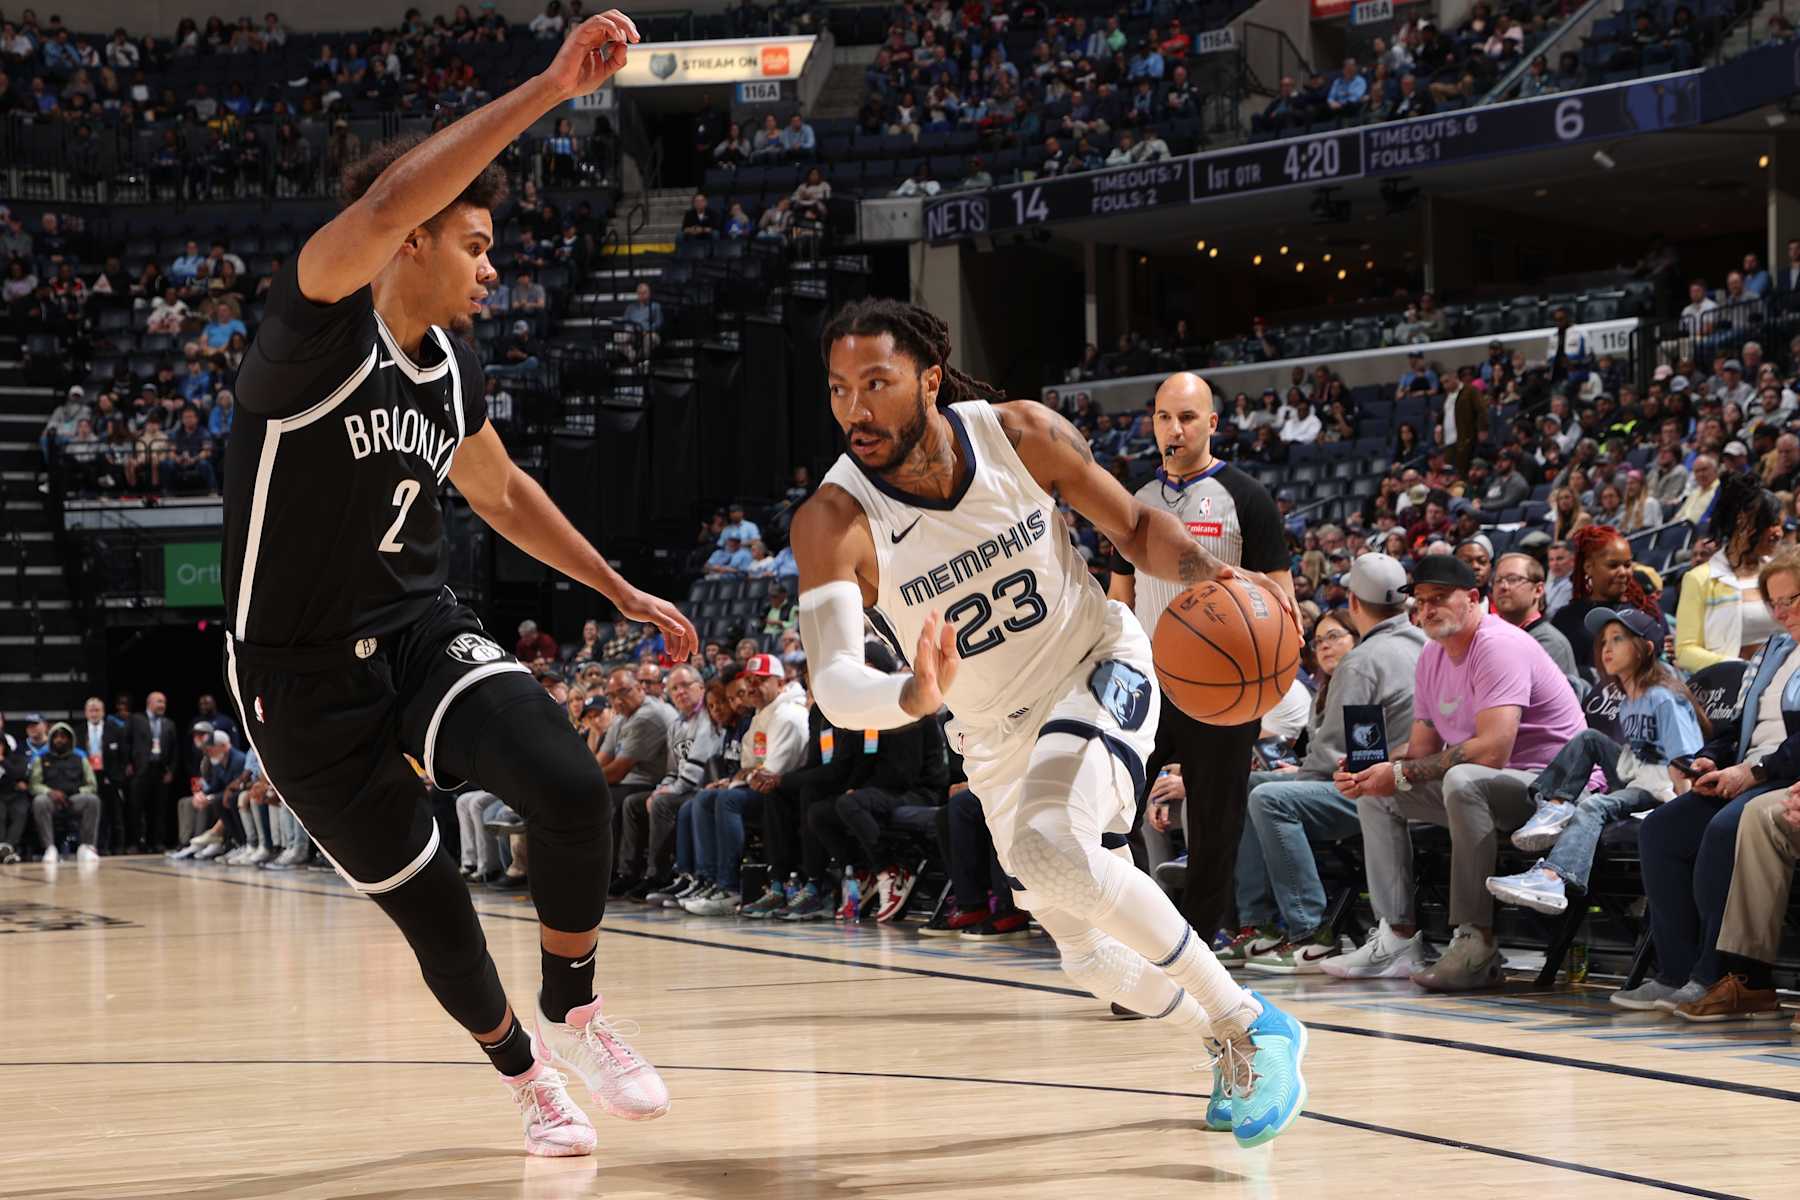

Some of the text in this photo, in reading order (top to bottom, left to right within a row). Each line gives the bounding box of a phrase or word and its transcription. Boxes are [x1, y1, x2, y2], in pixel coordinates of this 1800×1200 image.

[682, 57, 734, 71] STREAM
[739, 56, 758, 68] ON
[744, 83, 777, 99] 116A
[1370, 115, 1478, 147] TIMEOUTS: 6
[1554, 99, 1584, 140] 6
[1173, 163, 1184, 181] 7
[1283, 138, 1340, 182] 4:20
[1371, 143, 1441, 168] FOULS: 1
[1208, 163, 1262, 190] 1ST QTR
[927, 198, 985, 239] NETS
[1012, 187, 1049, 225] 14
[1092, 189, 1158, 213] FOULS: 2
[1601, 331, 1628, 349] 116
[344, 405, 456, 486] BROOKLYN
[378, 479, 421, 553] 2
[899, 509, 1046, 607] MEMPHIS
[944, 568, 1048, 659] 23
